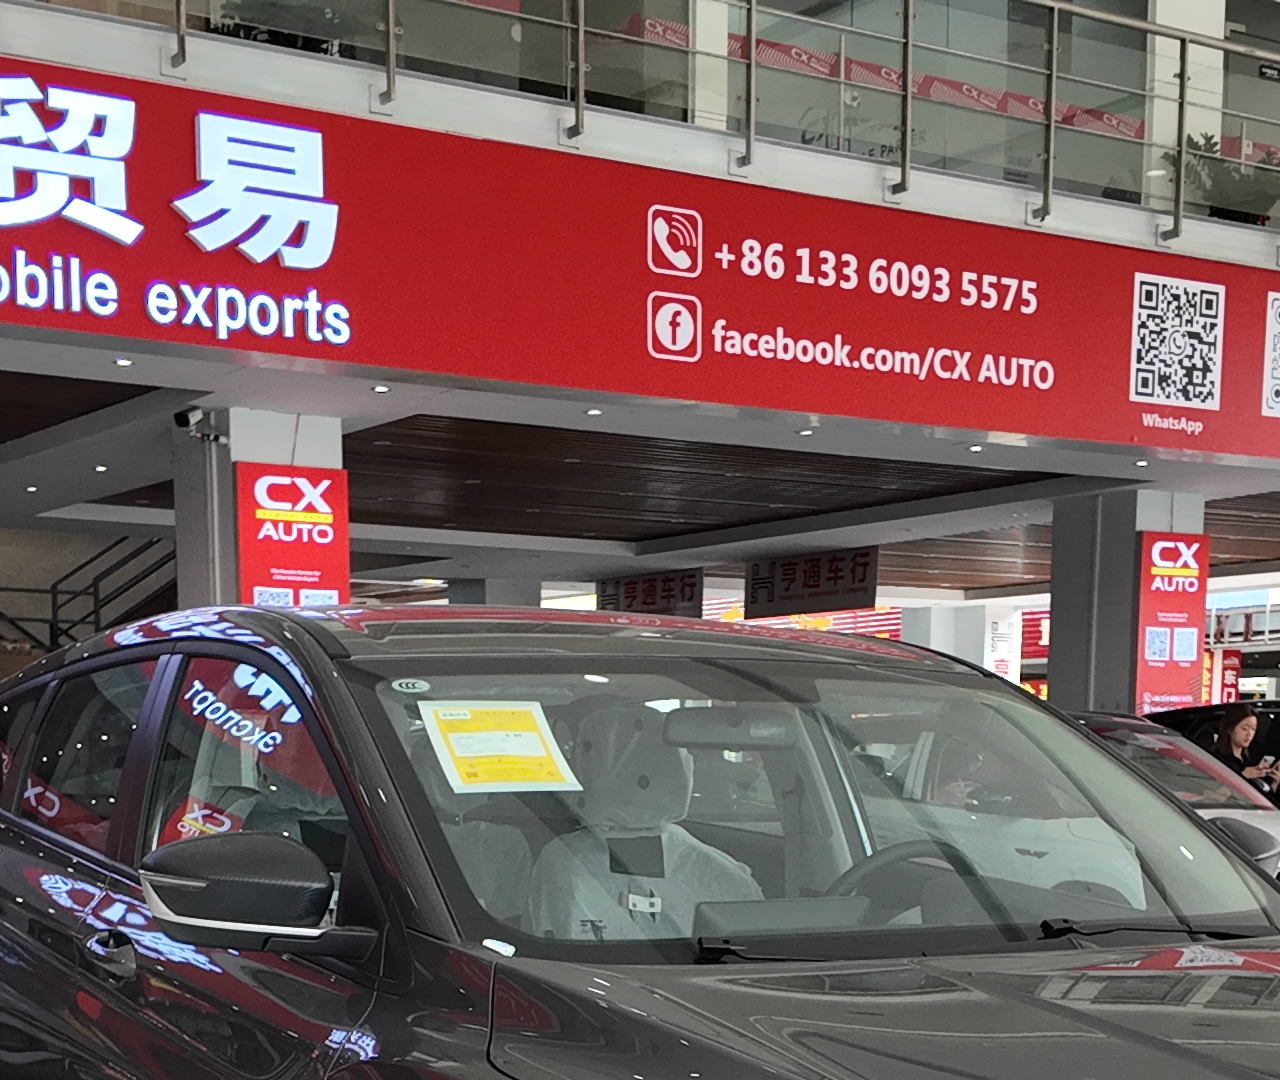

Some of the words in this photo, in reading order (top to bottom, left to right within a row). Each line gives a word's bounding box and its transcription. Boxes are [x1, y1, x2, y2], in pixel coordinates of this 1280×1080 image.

[645, 18, 664, 35] CX
[791, 48, 808, 63] CX
[714, 239, 785, 280] +86
[795, 247, 858, 290] 133
[868, 258, 951, 303] 6093
[960, 271, 1038, 315] 5575
[146, 281, 351, 345] exports
[711, 319, 971, 382] facebook.com/CX
[977, 353, 1055, 390] AUTO
[1142, 412, 1203, 436] WhatsApp
[254, 475, 333, 513] CX
[257, 521, 334, 544] AUTO
[1151, 540, 1201, 569] CX
[780, 552, 870, 592] 亨通车行
[1151, 576, 1199, 593] AUTO
[624, 574, 697, 608] 亨通车行
